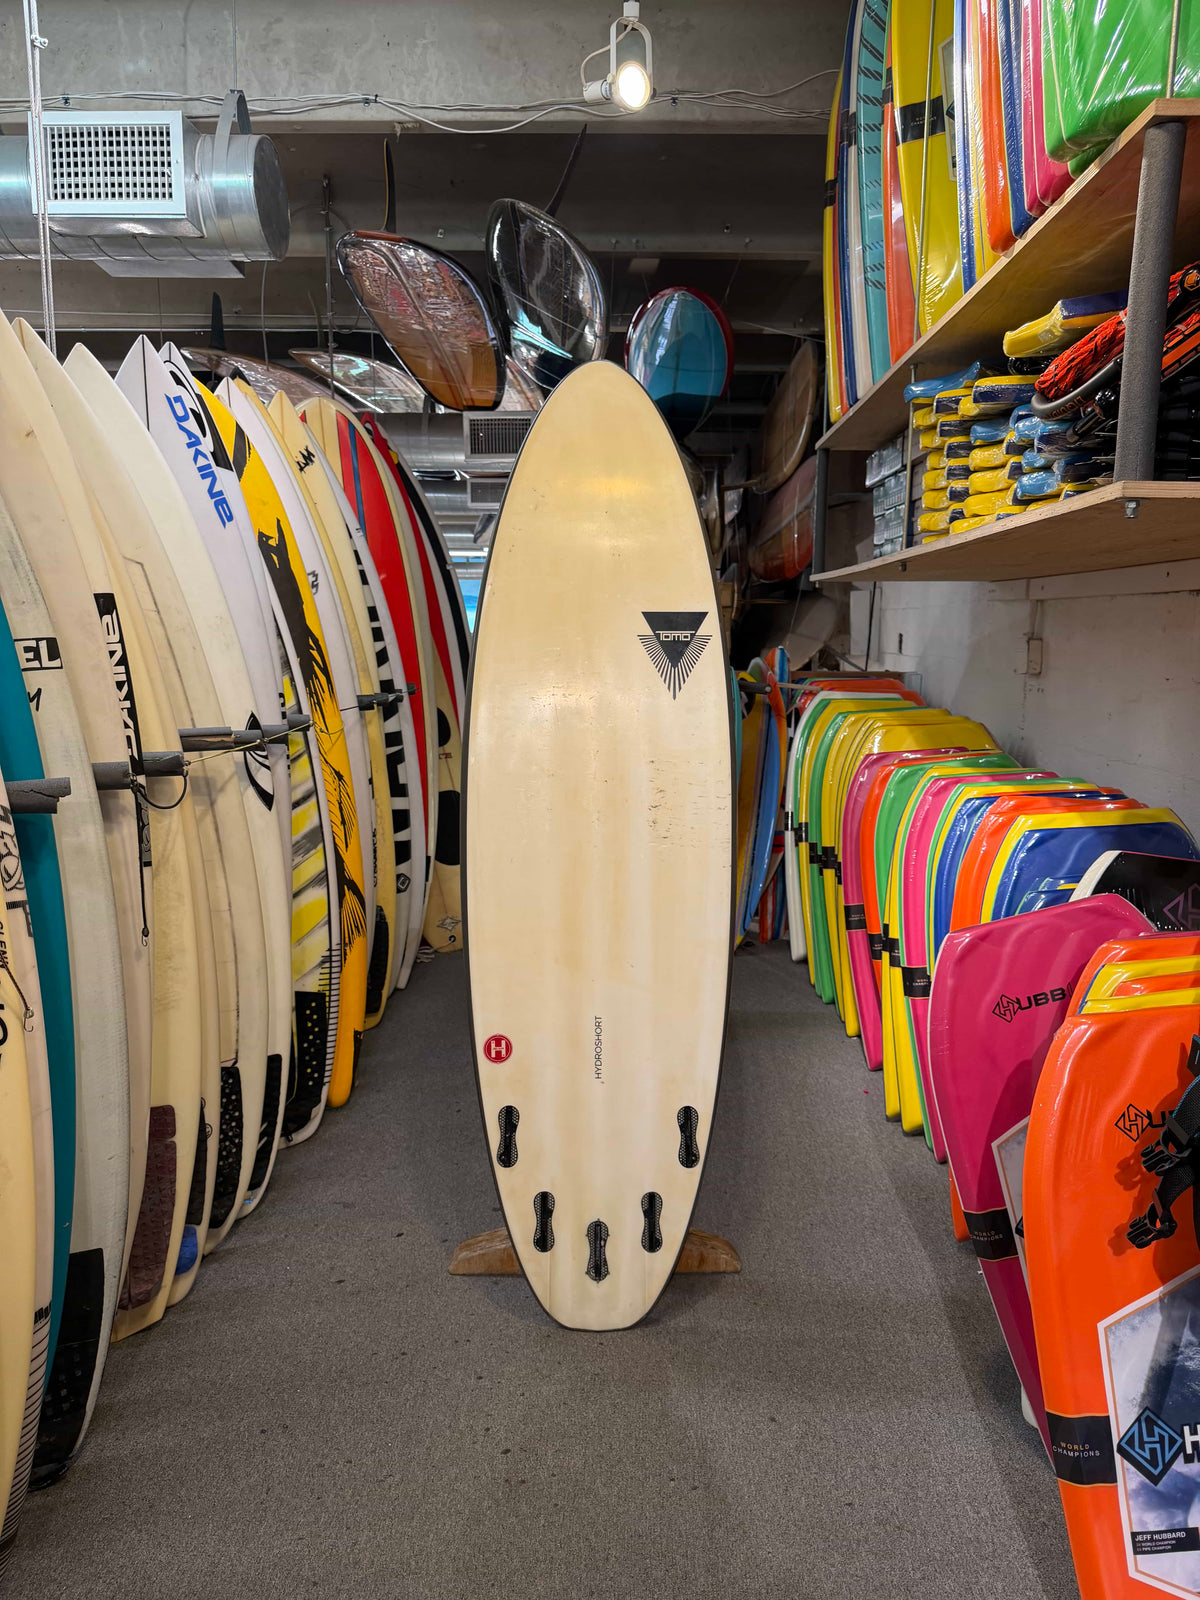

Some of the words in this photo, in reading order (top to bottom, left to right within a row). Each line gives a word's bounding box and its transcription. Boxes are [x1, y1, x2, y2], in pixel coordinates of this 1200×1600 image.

[164, 393, 234, 529] DAKINE
[655, 630, 696, 641] TOMO
[594, 1015, 603, 1080] HYDROSHORT
[1052, 1445, 1101, 1459] CHAMPIONS
[1060, 1441, 1090, 1451] WORLD
[1153, 1532, 1186, 1540] HUBBARD
